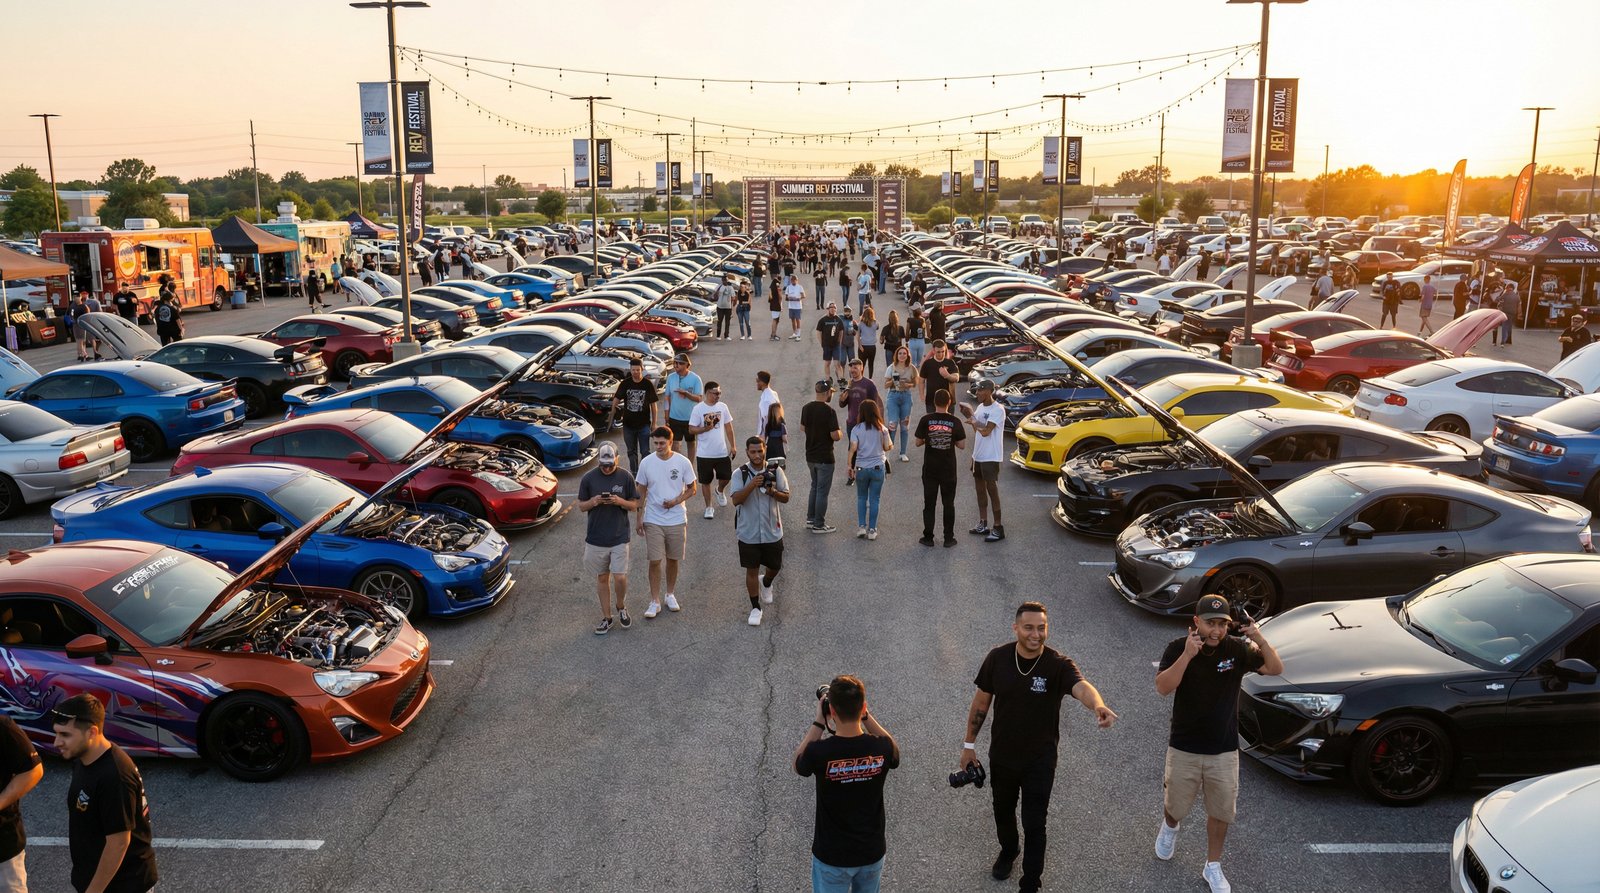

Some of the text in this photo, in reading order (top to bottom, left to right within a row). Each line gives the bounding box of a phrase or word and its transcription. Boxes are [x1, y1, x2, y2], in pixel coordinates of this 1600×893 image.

[407, 91, 421, 129] FESTIVAL
[1273, 88, 1286, 127] FESTIVAL
[408, 131, 423, 153] REV
[1270, 129, 1285, 151] REV
[782, 183, 865, 194] SUMMER REV FESTIVAL
